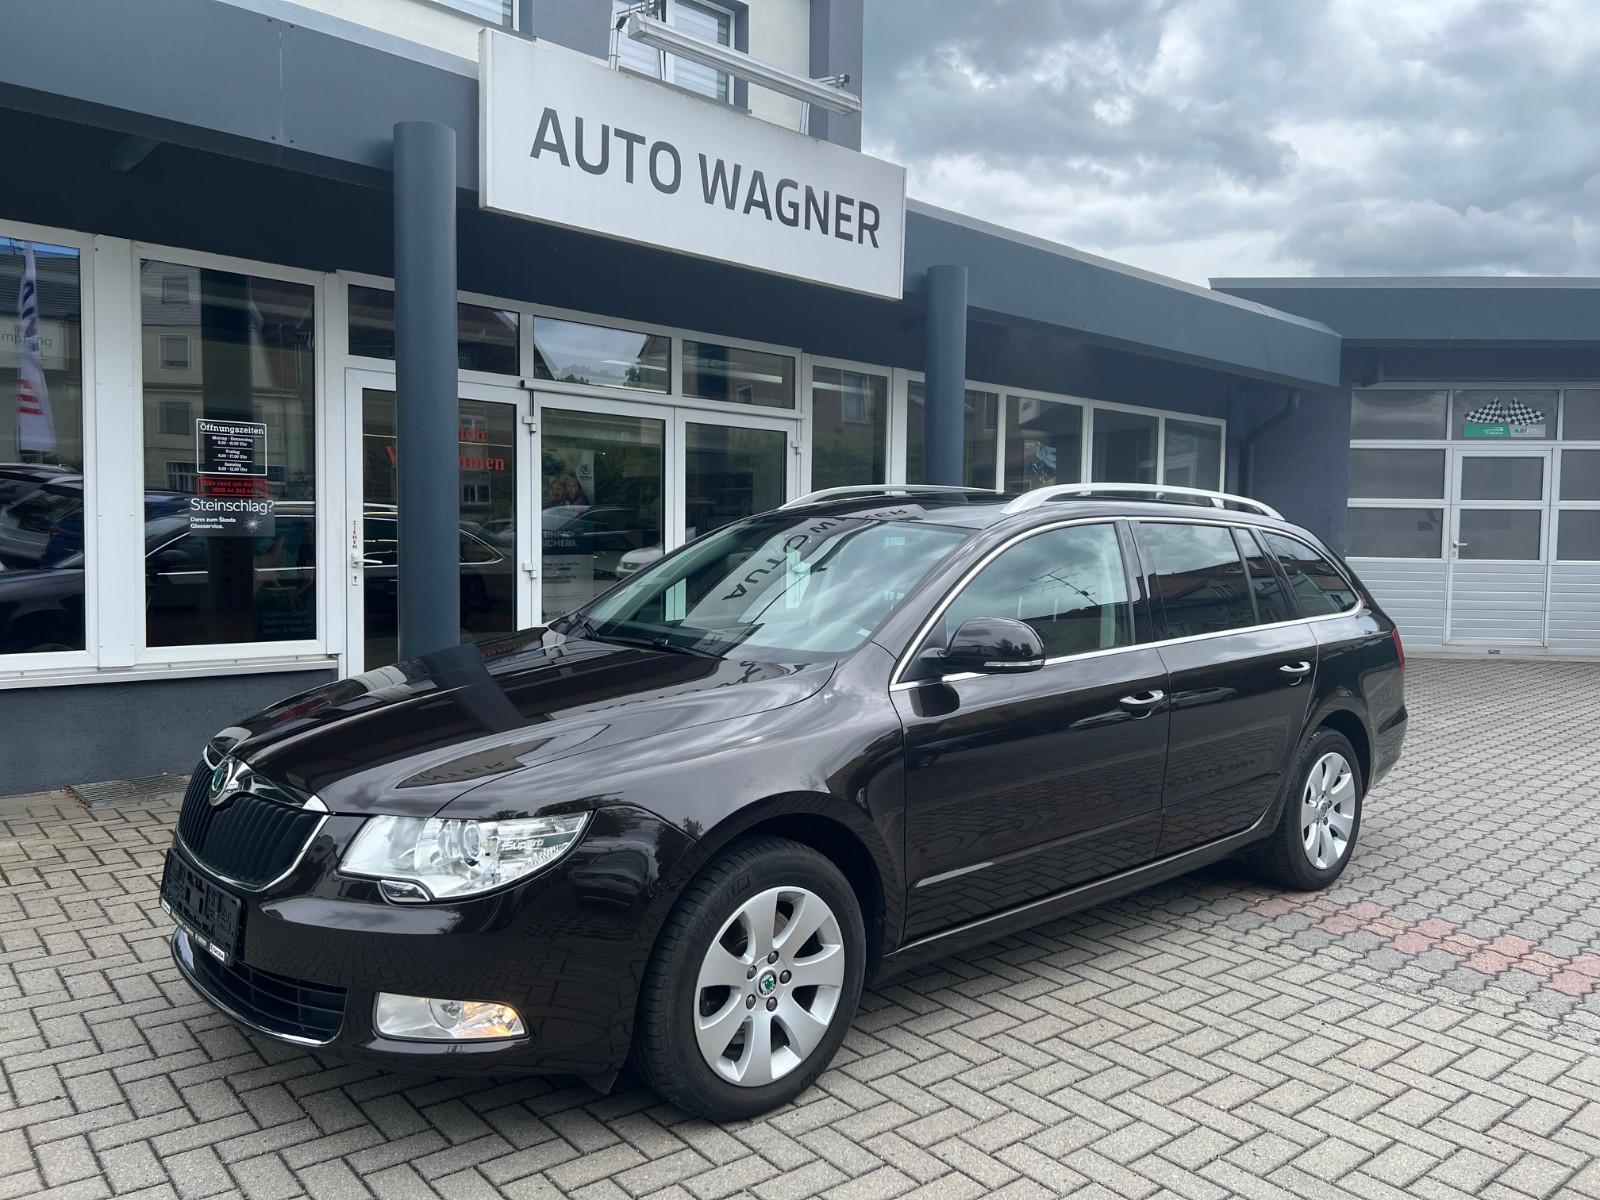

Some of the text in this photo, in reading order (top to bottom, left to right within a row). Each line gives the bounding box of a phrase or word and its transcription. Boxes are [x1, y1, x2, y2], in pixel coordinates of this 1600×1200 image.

[530, 106, 881, 248] AUTO WAGNER
[200, 422, 264, 435] Öffnungszeiten
[190, 497, 275, 516] Steinschlag?
